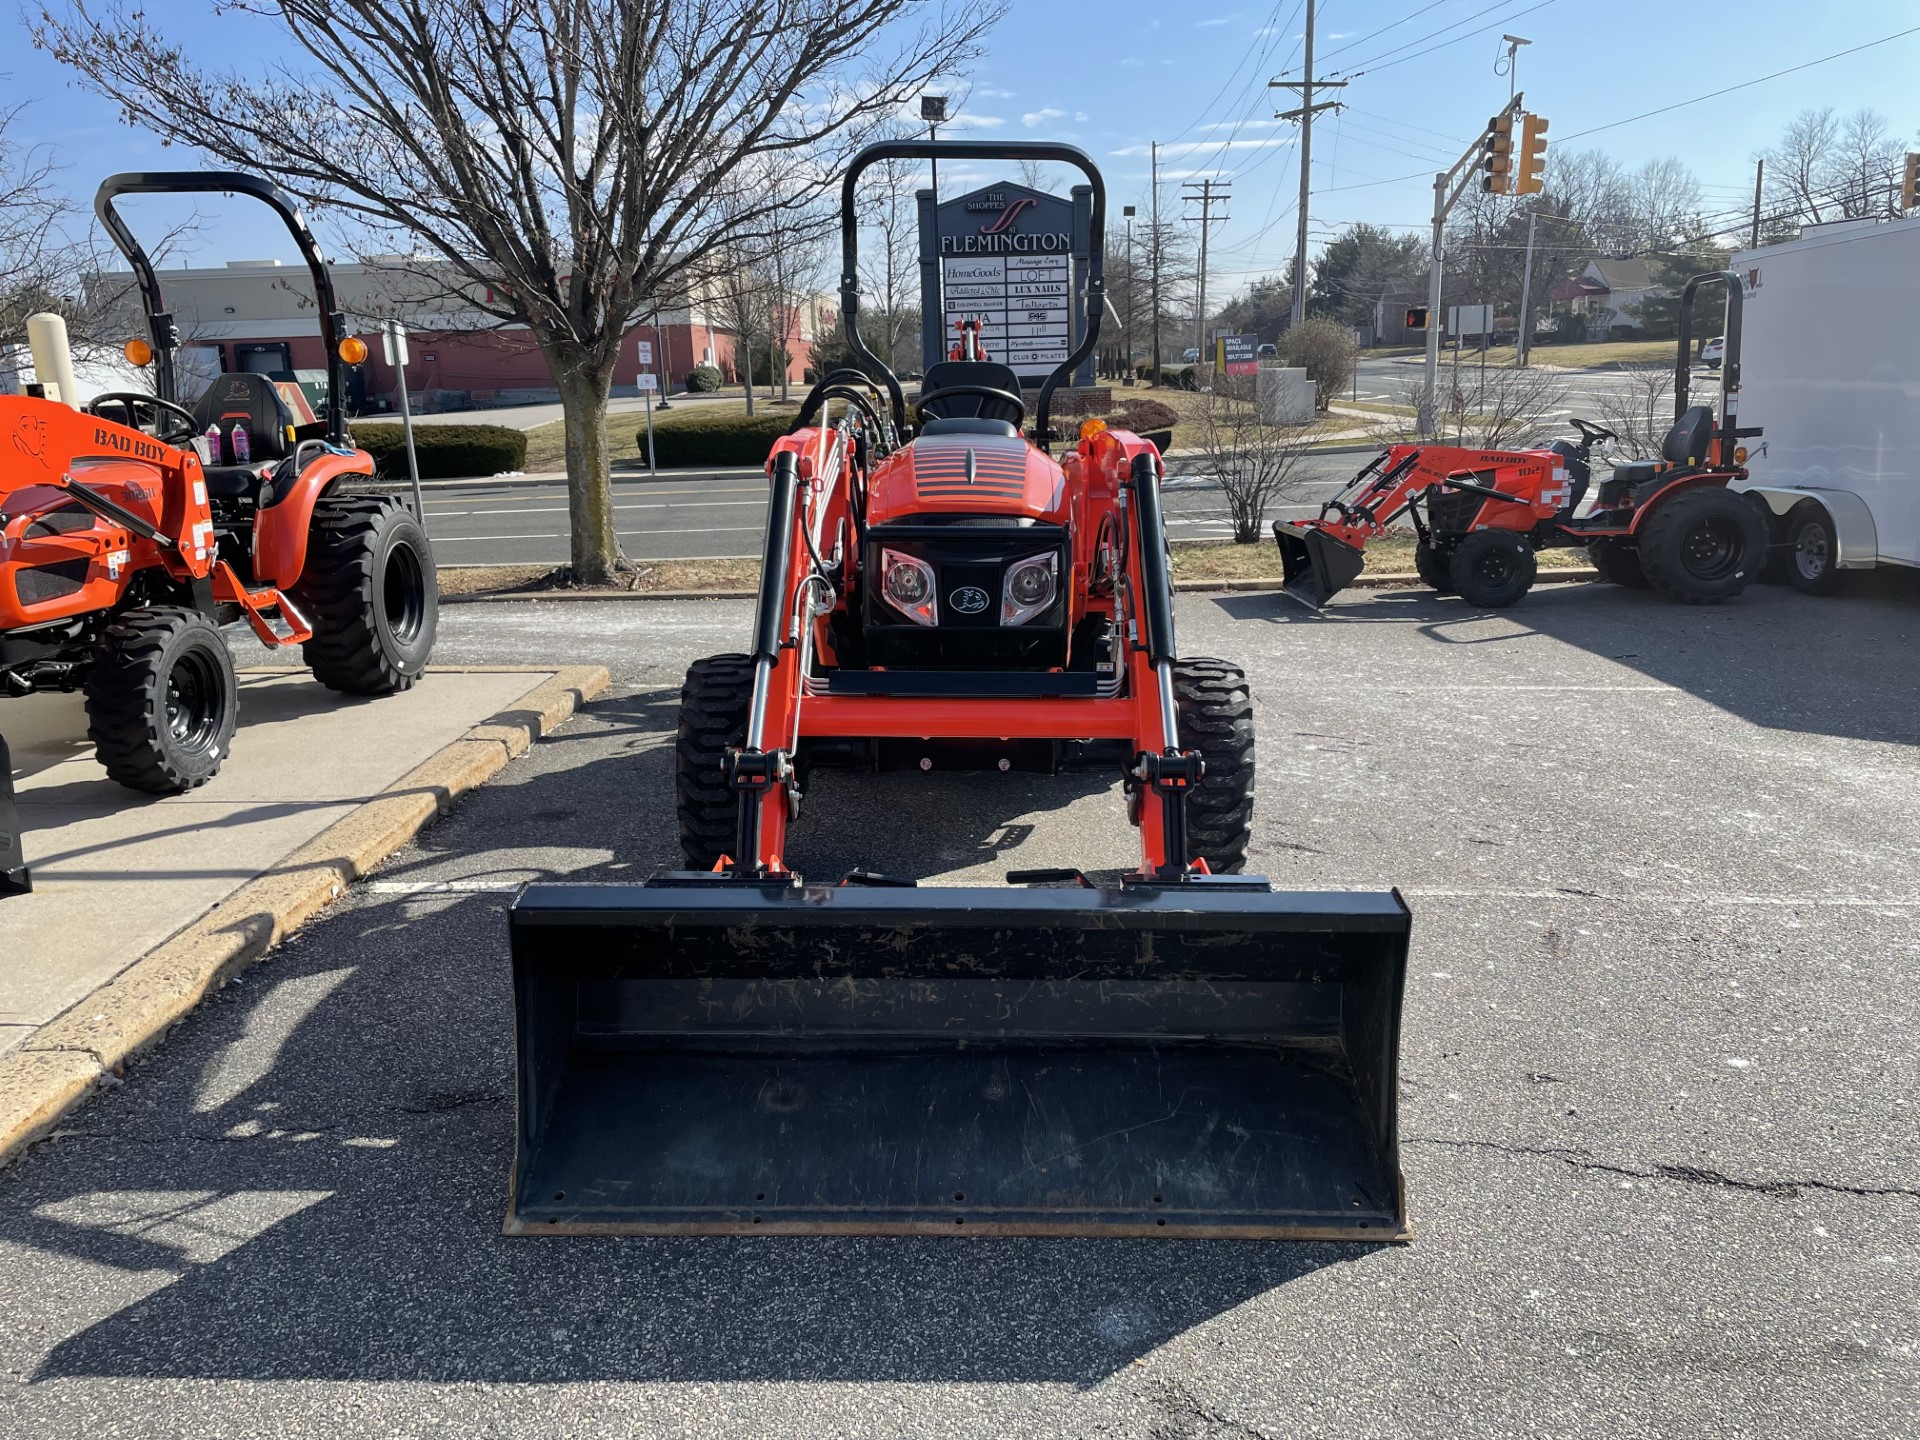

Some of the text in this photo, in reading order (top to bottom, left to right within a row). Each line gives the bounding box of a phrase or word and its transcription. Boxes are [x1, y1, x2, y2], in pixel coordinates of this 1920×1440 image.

[967, 202, 1005, 210] SHOPPES
[941, 233, 1071, 253] FLEMINGTON
[947, 267, 1001, 279] HomeGoods
[1020, 270, 1054, 282] LOFT
[1015, 284, 1061, 294] LUX NAILS
[94, 428, 167, 462] BAD BOY
[1480, 455, 1504, 463] BAD
